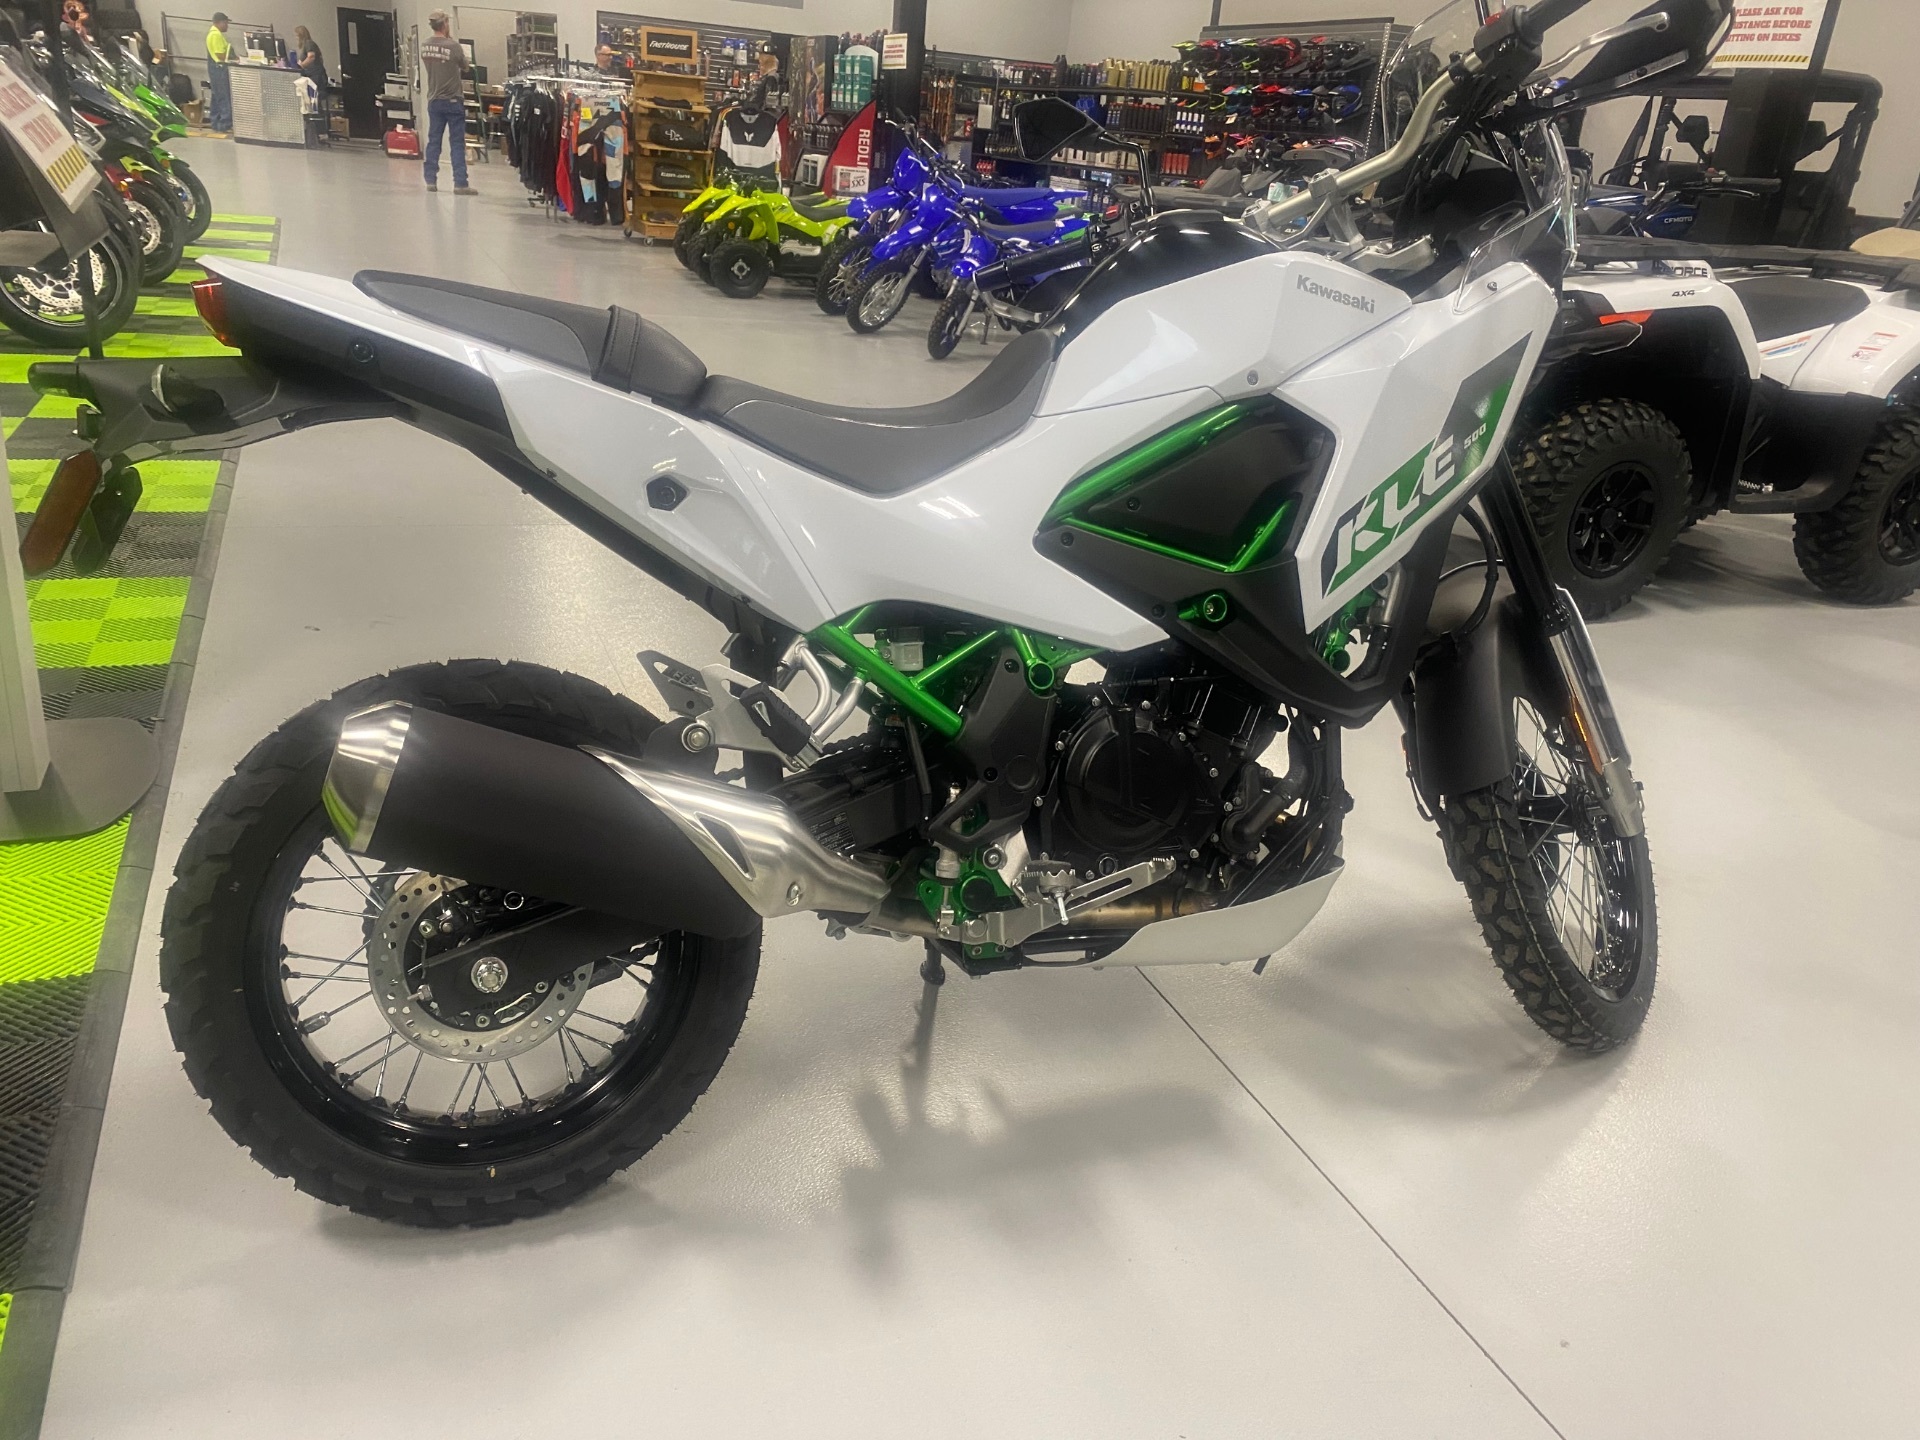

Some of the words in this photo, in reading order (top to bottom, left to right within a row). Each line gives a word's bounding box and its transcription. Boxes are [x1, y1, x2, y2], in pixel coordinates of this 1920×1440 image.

[1764, 7, 1782, 15] ASK
[1783, 7, 1803, 15] FOR
[1733, 21, 1771, 29] ISTANCE
[1772, 20, 1812, 29] BEFORE
[1726, 34, 1755, 42] ITTING
[1757, 33, 1770, 41] ON
[1771, 33, 1801, 41] BIKES
[857, 128, 870, 168] REDLI
[1664, 216, 1693, 224] CFMOTO
[1673, 266, 1708, 277] ORCE
[1296, 274, 1375, 314] Kawasaki
[1671, 289, 1695, 297] 4X4
[1463, 422, 1487, 449] 500
[1336, 434, 1455, 569] KLE
